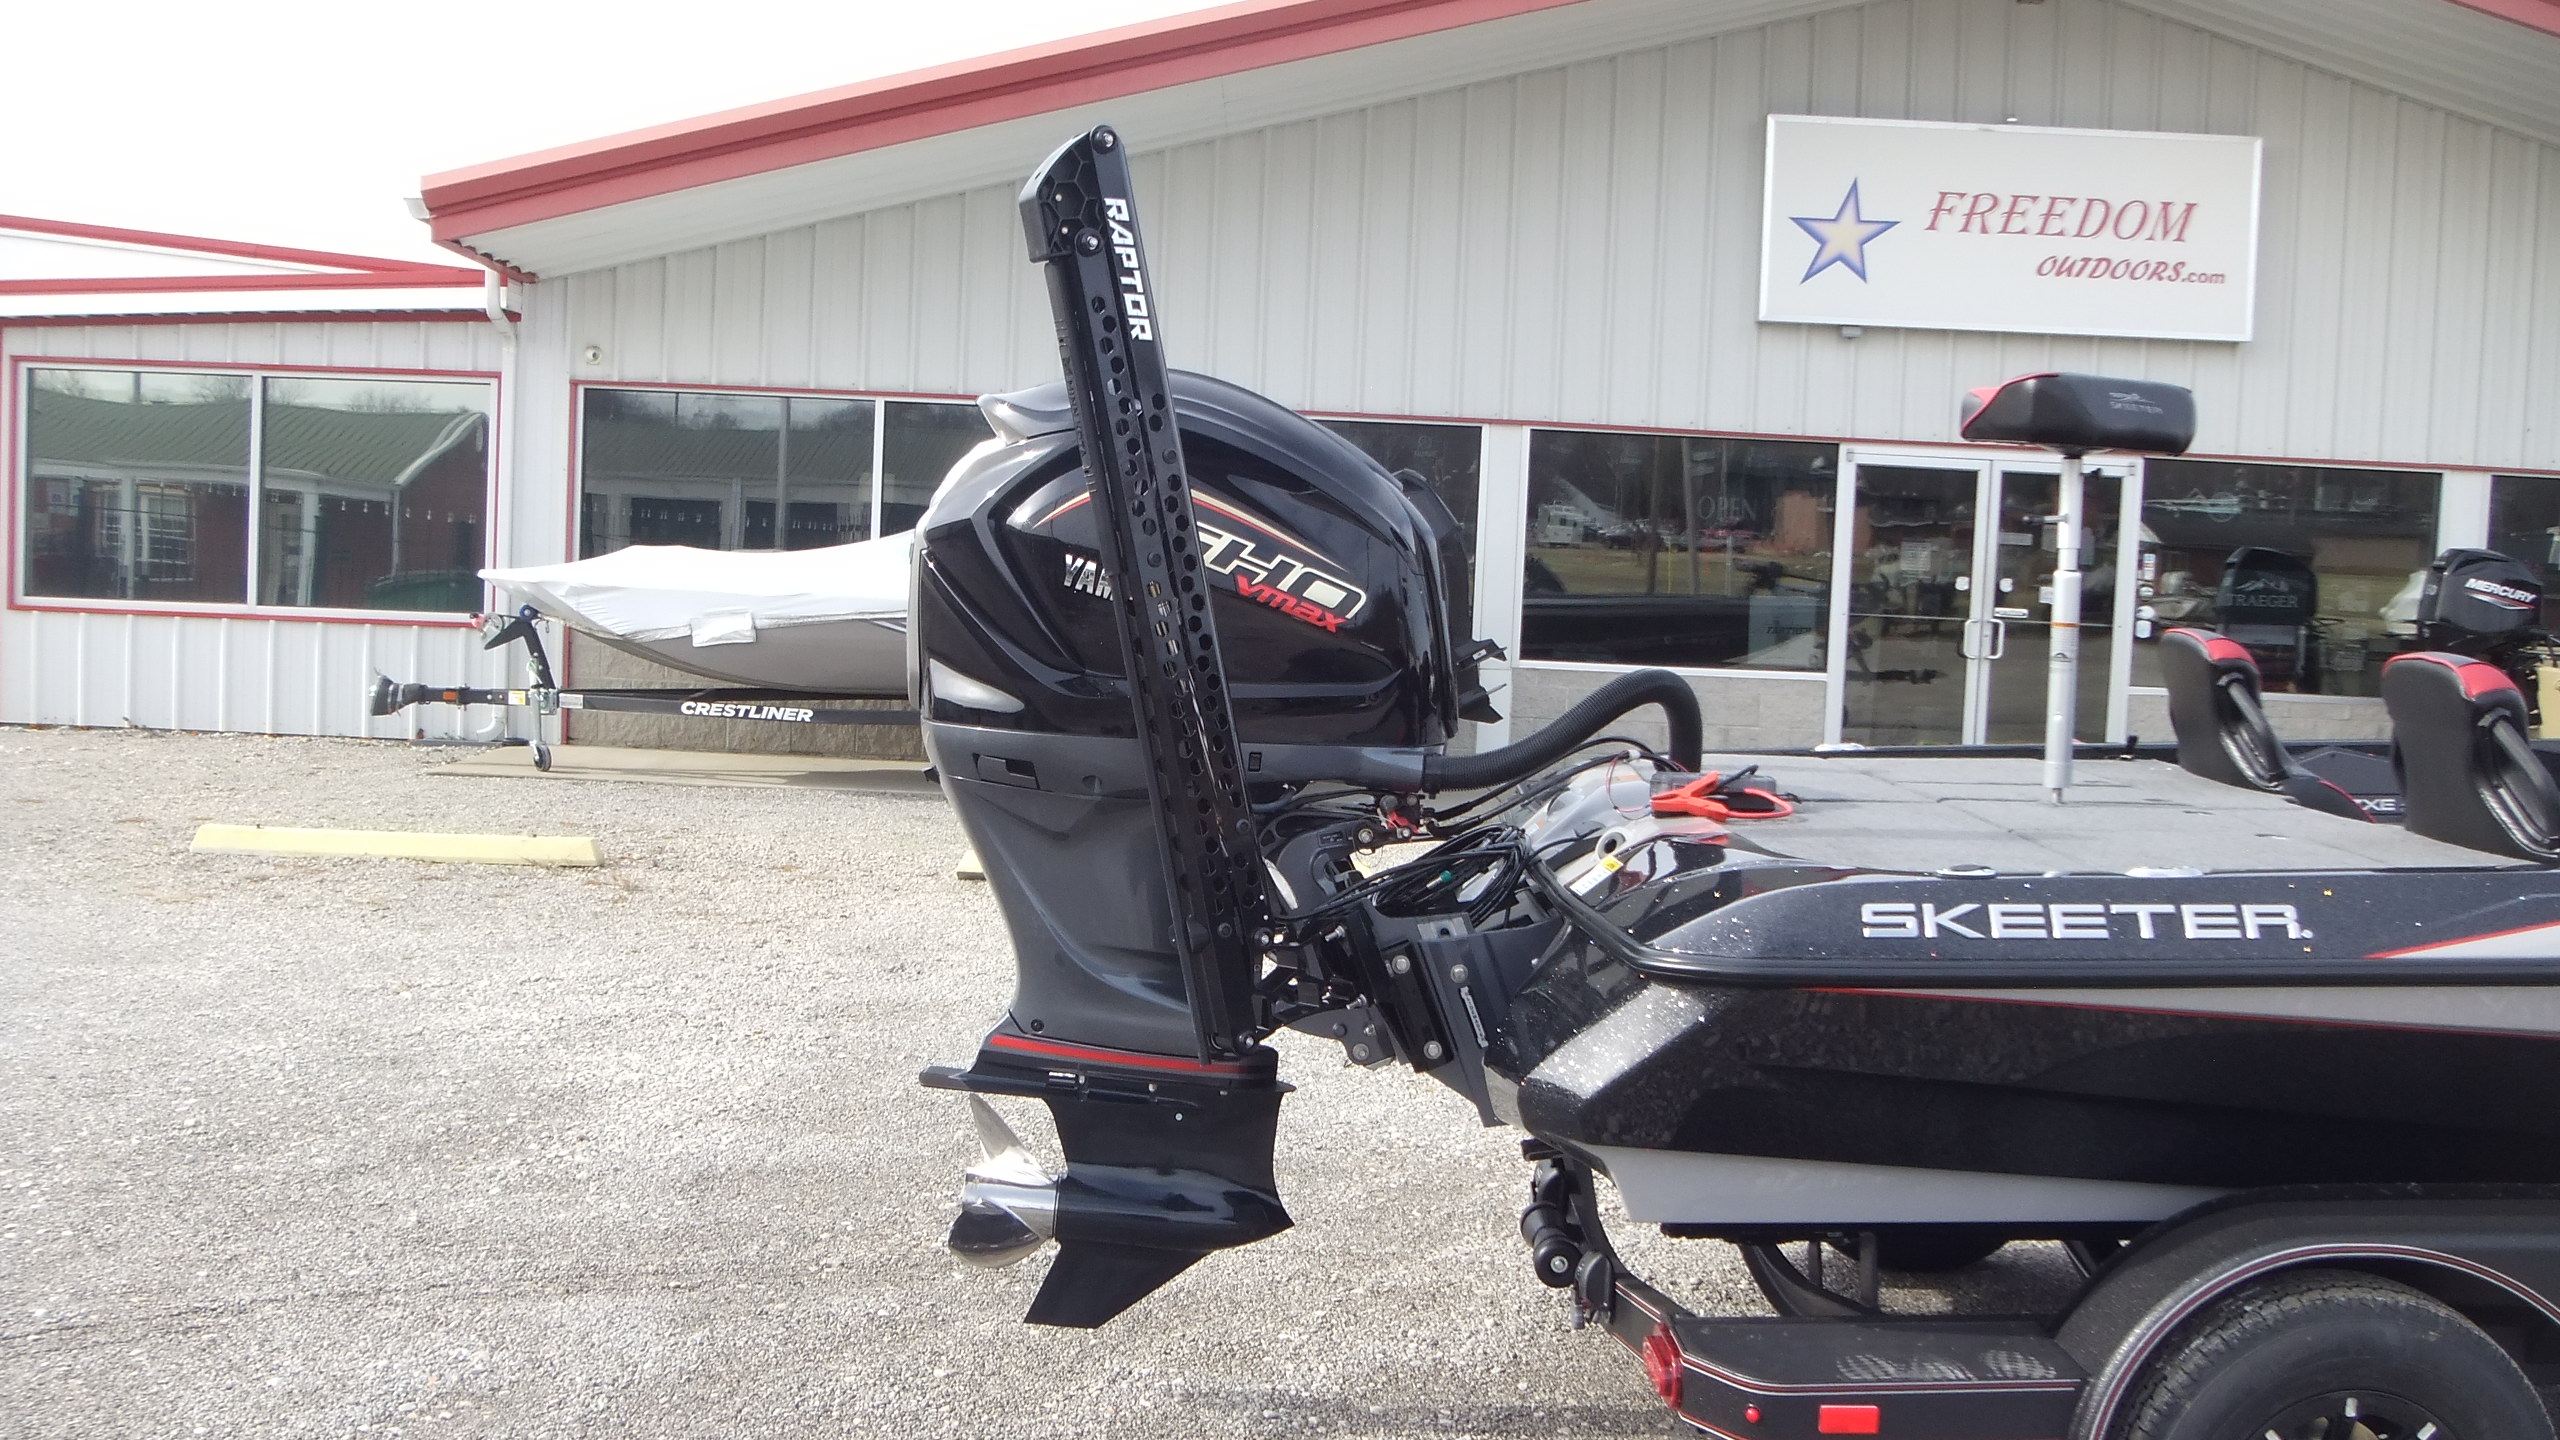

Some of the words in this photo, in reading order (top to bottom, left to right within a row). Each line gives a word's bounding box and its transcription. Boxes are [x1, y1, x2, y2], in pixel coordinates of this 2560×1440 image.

[1923, 191, 2198, 242] FREEDOM
[1103, 198, 1153, 341] RAPTOR
[1698, 495, 1757, 521] OPEN
[1063, 553, 1114, 601] YAM
[2464, 578, 2538, 603] MERCURY
[680, 701, 814, 722] CRESTLINER
[1861, 903, 2304, 939] SKEETER
